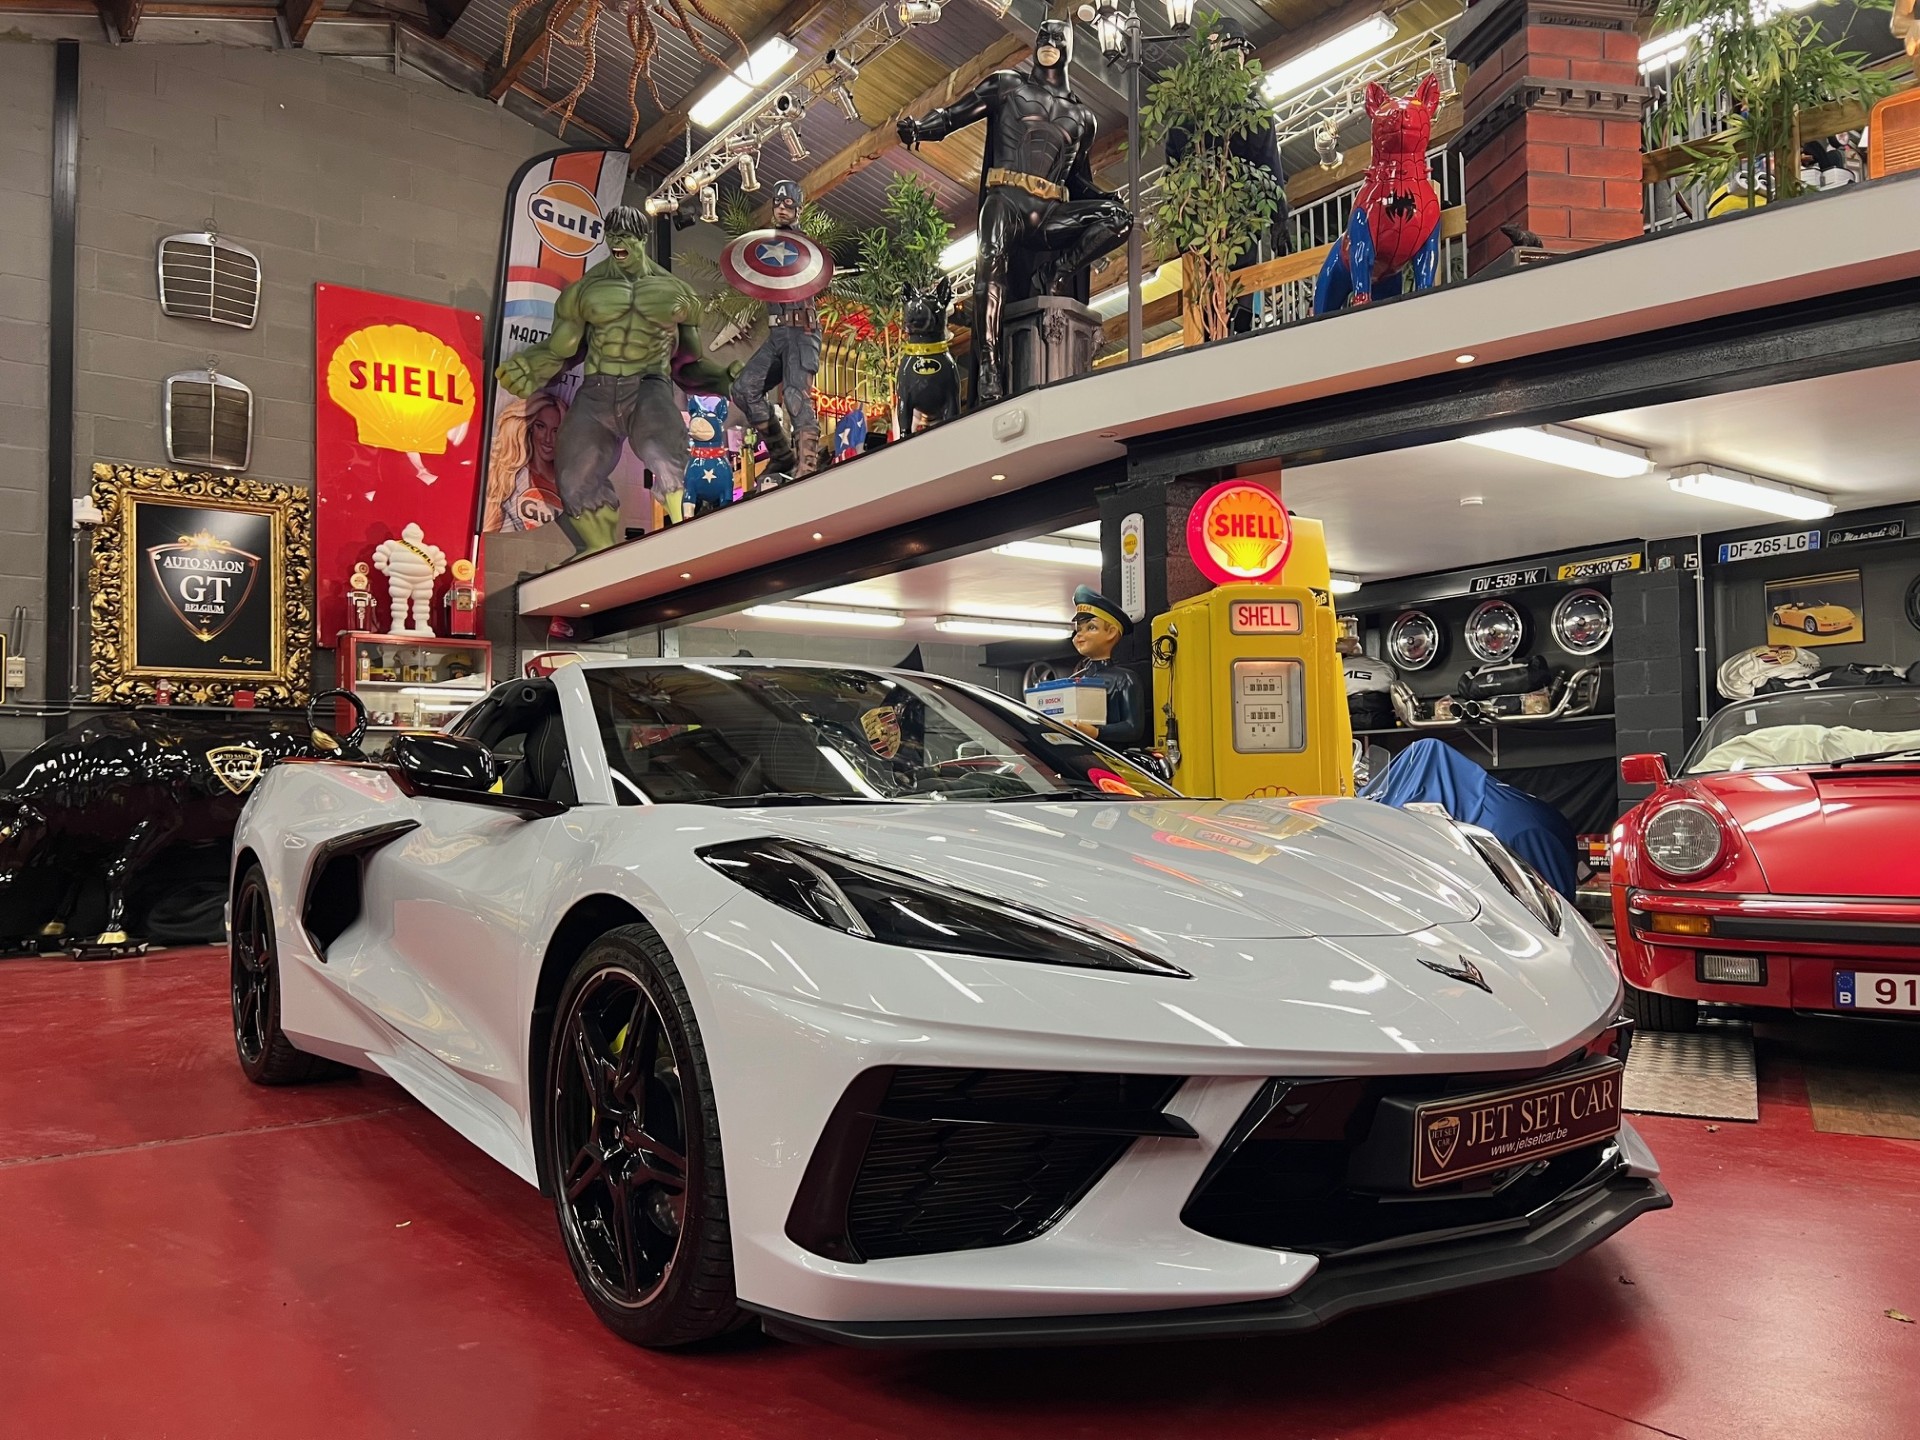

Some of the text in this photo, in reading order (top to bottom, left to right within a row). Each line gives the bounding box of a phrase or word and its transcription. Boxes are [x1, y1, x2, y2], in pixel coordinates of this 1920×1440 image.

[777, 185, 787, 197] A
[531, 198, 602, 240] Gulf
[349, 360, 464, 405] SHELL
[1215, 514, 1279, 539] SHELL
[1843, 527, 1887, 541] Maserati
[1729, 535, 1806, 557] DF-265-LG
[163, 556, 244, 573] AUTO SALON
[180, 575, 231, 603] GT
[185, 604, 224, 613] BELGIUM
[1238, 606, 1291, 626] SHELL
[1840, 991, 1852, 1003] B
[1875, 978, 1917, 1006] 91
[1466, 1079, 1614, 1147] JET SET CAR
[1432, 1128, 1457, 1139] JET SET
[1437, 1138, 1450, 1147] CAR
[1491, 1127, 1568, 1157] www.jetsetcar.be
